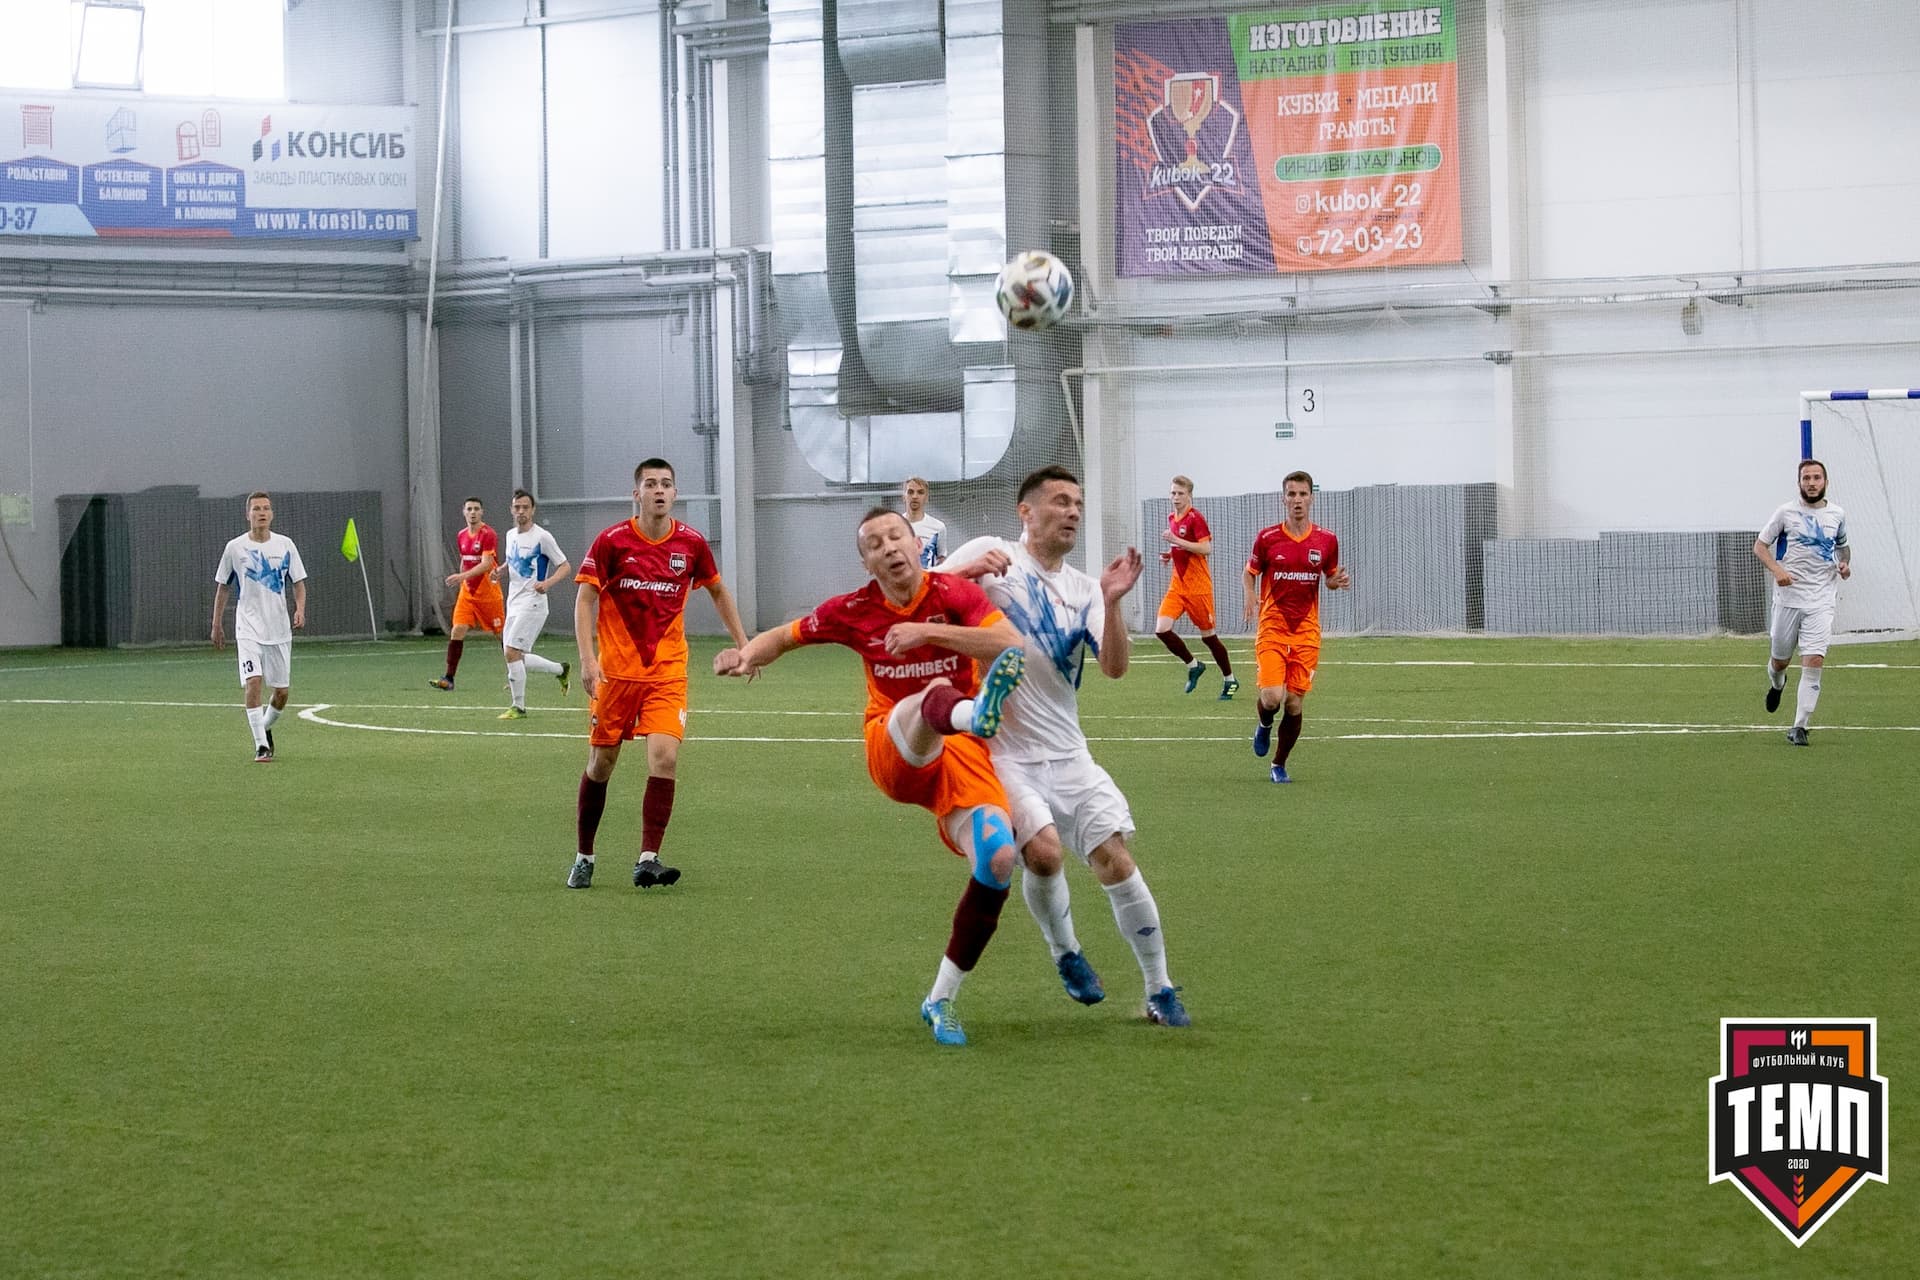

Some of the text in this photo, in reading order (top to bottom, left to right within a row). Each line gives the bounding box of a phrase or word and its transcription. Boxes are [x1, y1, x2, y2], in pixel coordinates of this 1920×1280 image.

[1249, 7, 1442, 51] ИЗГОТОВЛЕНИЕ
[1350, 42, 1443, 66] ПРОДУКЦИИ
[1277, 82, 1438, 116] КУБКИ МЕДАЛИ
[1319, 117, 1396, 141] ГРАМОТЫ
[288, 131, 406, 159] КОНСИБ
[94, 170, 150, 183] ОСТЕКЛЕНИЕ
[173, 171, 196, 184] ОКНА
[199, 172, 206, 185] И
[253, 171, 407, 187] ЗАВОДЫ ПЛАСТИКОВЫХ ОКОН
[99, 187, 148, 200] БАЛКОНОВ
[175, 189, 236, 203] ИЗ ПЛАСТИКА
[1315, 183, 1422, 213] kubok_22
[255, 210, 409, 231] www.konsib.com
[1145, 225, 1242, 243] ТВОИ ПОБЕДЫ!
[1317, 223, 1423, 255] 72-03-23
[1145, 244, 1243, 262] ТВОИ НАГРАДЫ!
[1303, 389, 1315, 412] 3
